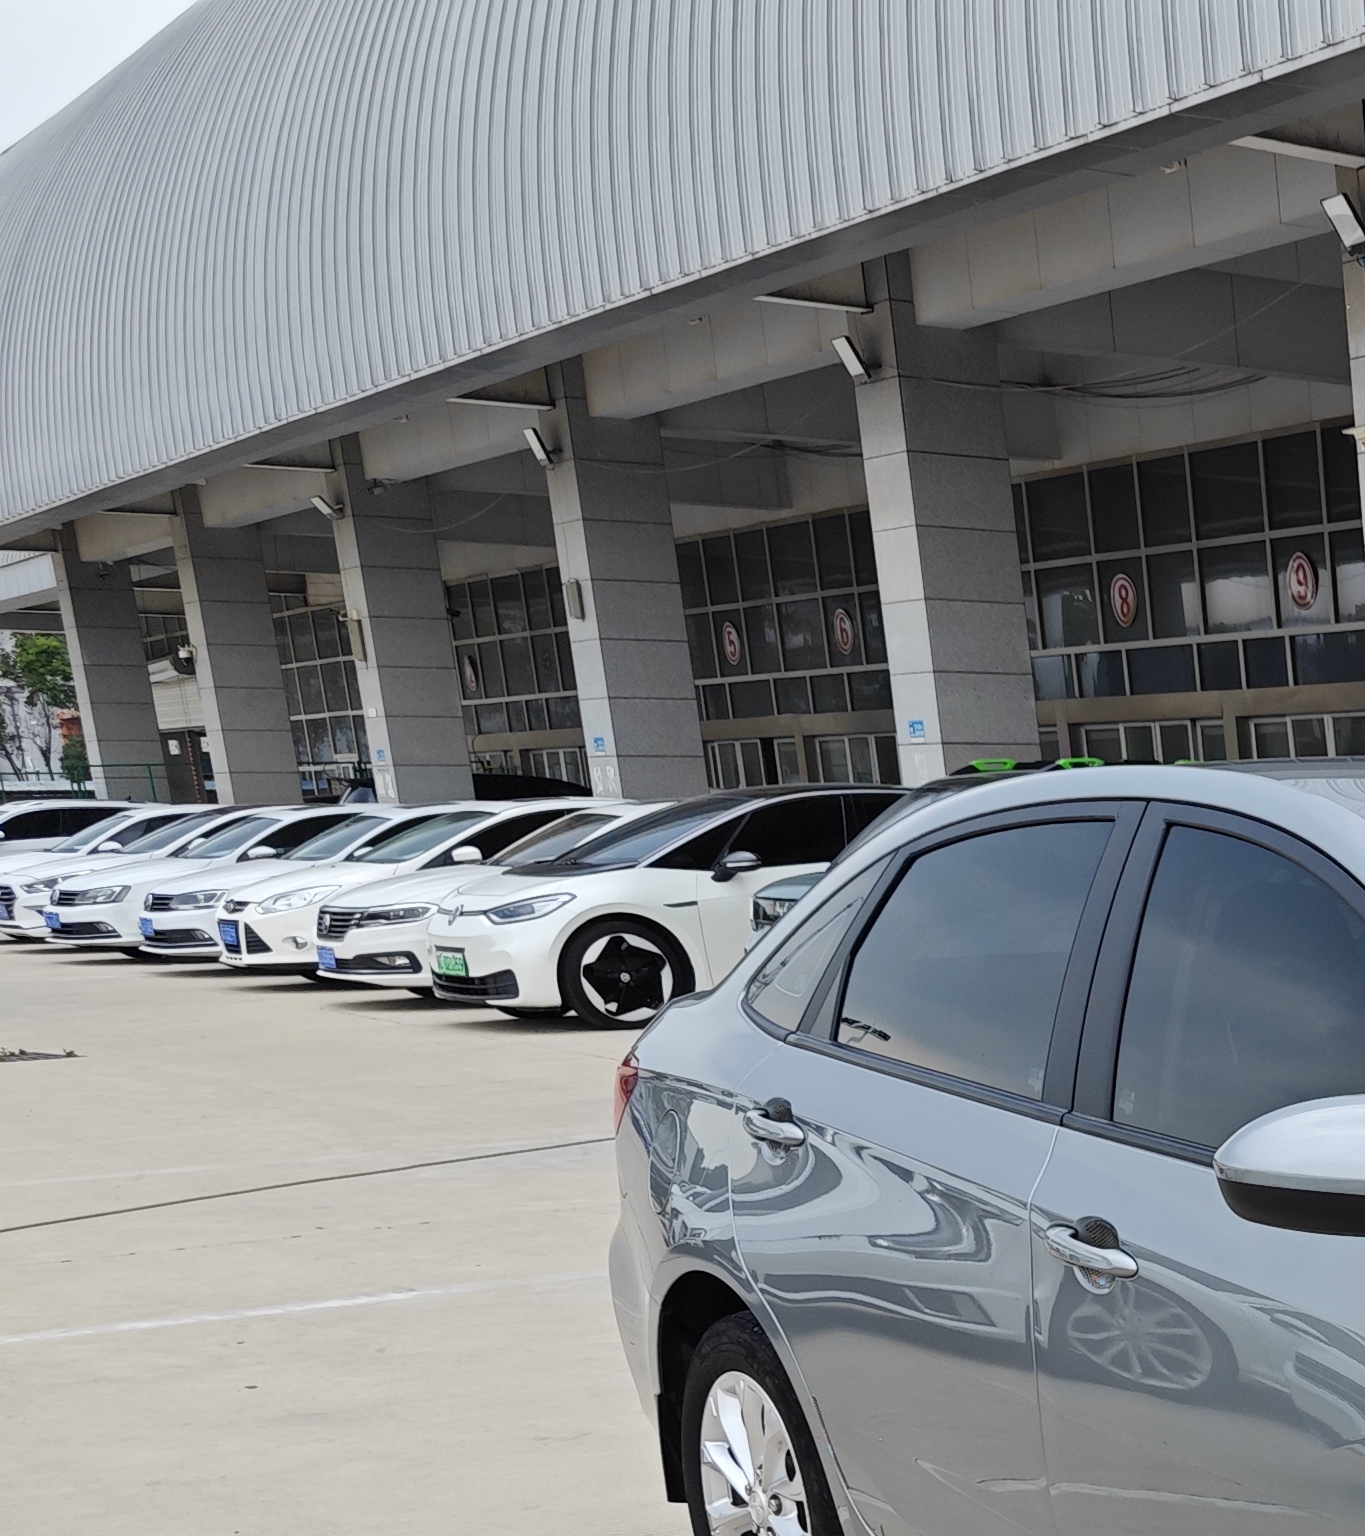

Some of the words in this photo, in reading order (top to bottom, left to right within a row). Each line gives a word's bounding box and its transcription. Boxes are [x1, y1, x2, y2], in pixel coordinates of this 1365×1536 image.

[1295, 562, 1309, 601] 9
[1118, 583, 1131, 619] 8
[727, 631, 737, 659] 5
[839, 618, 850, 647] 6
